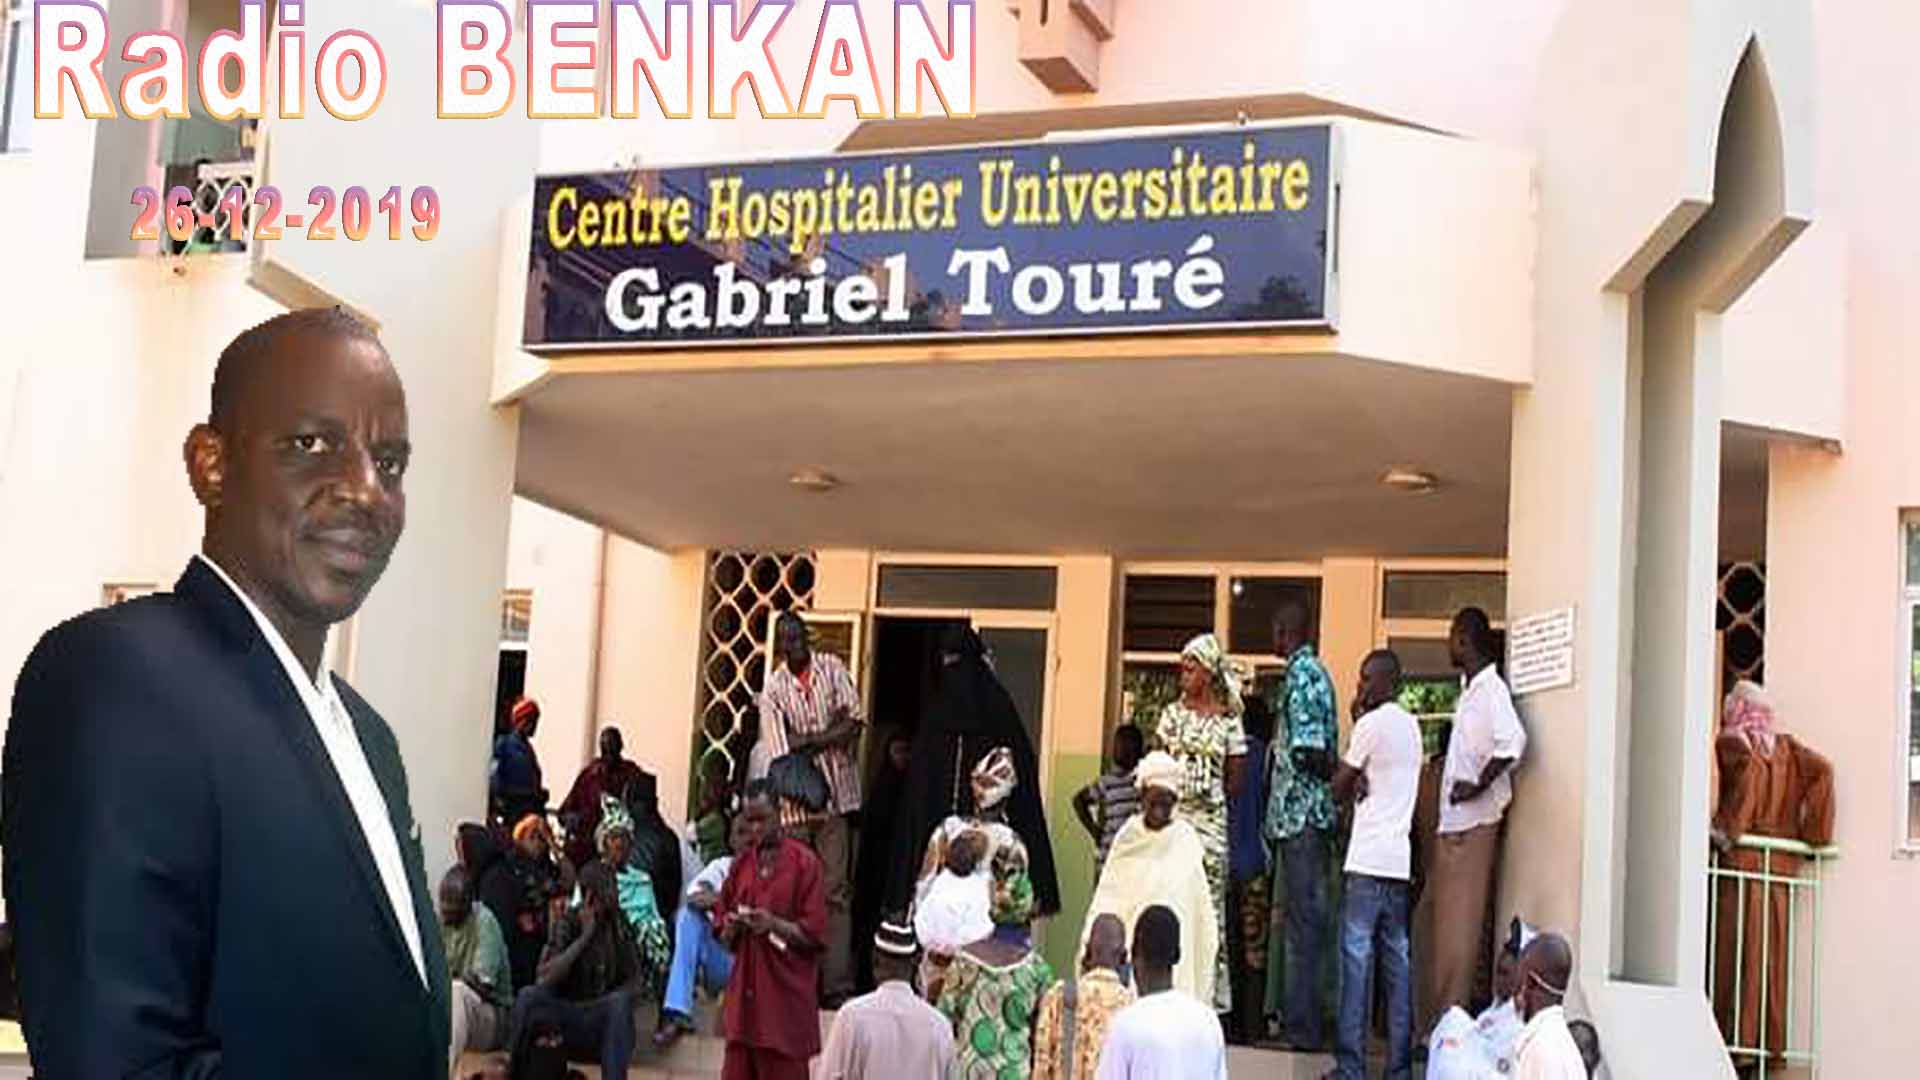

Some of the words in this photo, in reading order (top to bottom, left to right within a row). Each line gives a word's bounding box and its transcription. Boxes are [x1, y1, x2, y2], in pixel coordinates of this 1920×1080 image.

[547, 184, 691, 250] Centre
[706, 164, 964, 253] Hospitalier
[978, 140, 1310, 228] Universitaire
[604, 252, 911, 334] Gabriel
[947, 235, 1225, 317] Touré
